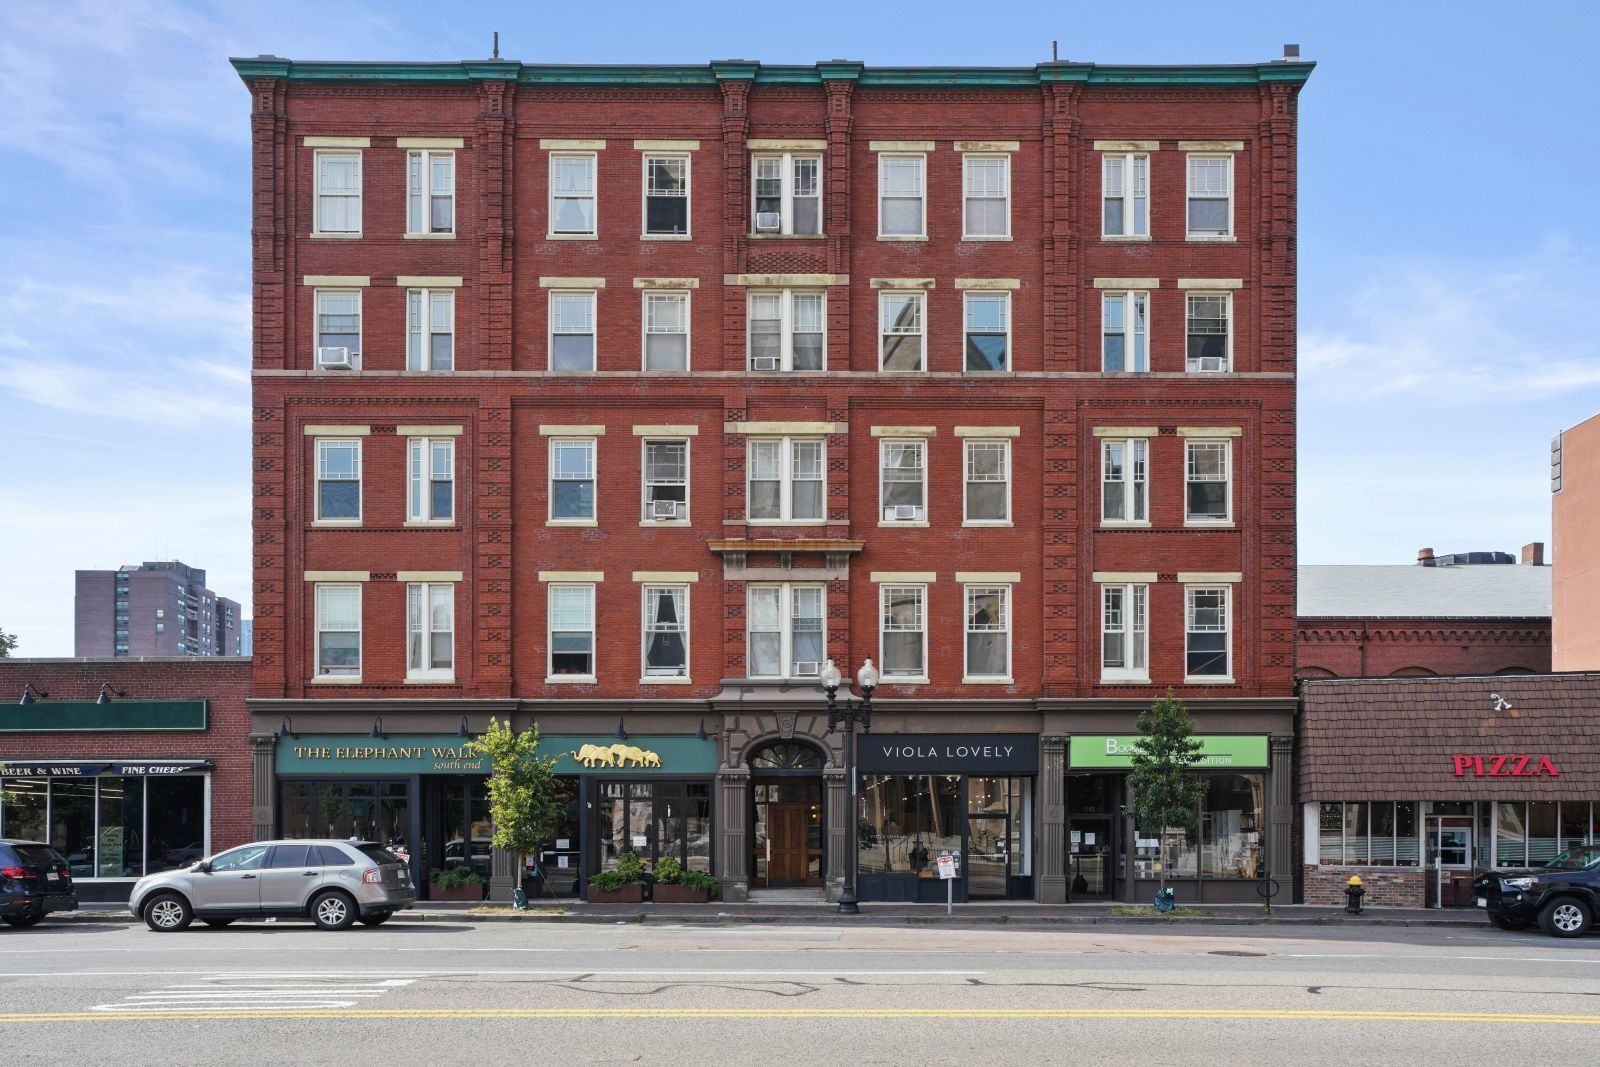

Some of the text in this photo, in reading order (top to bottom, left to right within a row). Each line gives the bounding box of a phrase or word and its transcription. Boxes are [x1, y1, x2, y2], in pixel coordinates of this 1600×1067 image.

[294, 747, 479, 760] THE ELEPHANT WALK
[883, 746, 1013, 758] VIOLA LOVELY
[433, 758, 484, 769] south end
[1452, 754, 1559, 776] PIZZA
[1, 767, 82, 776] BEER & WINE
[121, 766, 191, 774] FINE CHEES
